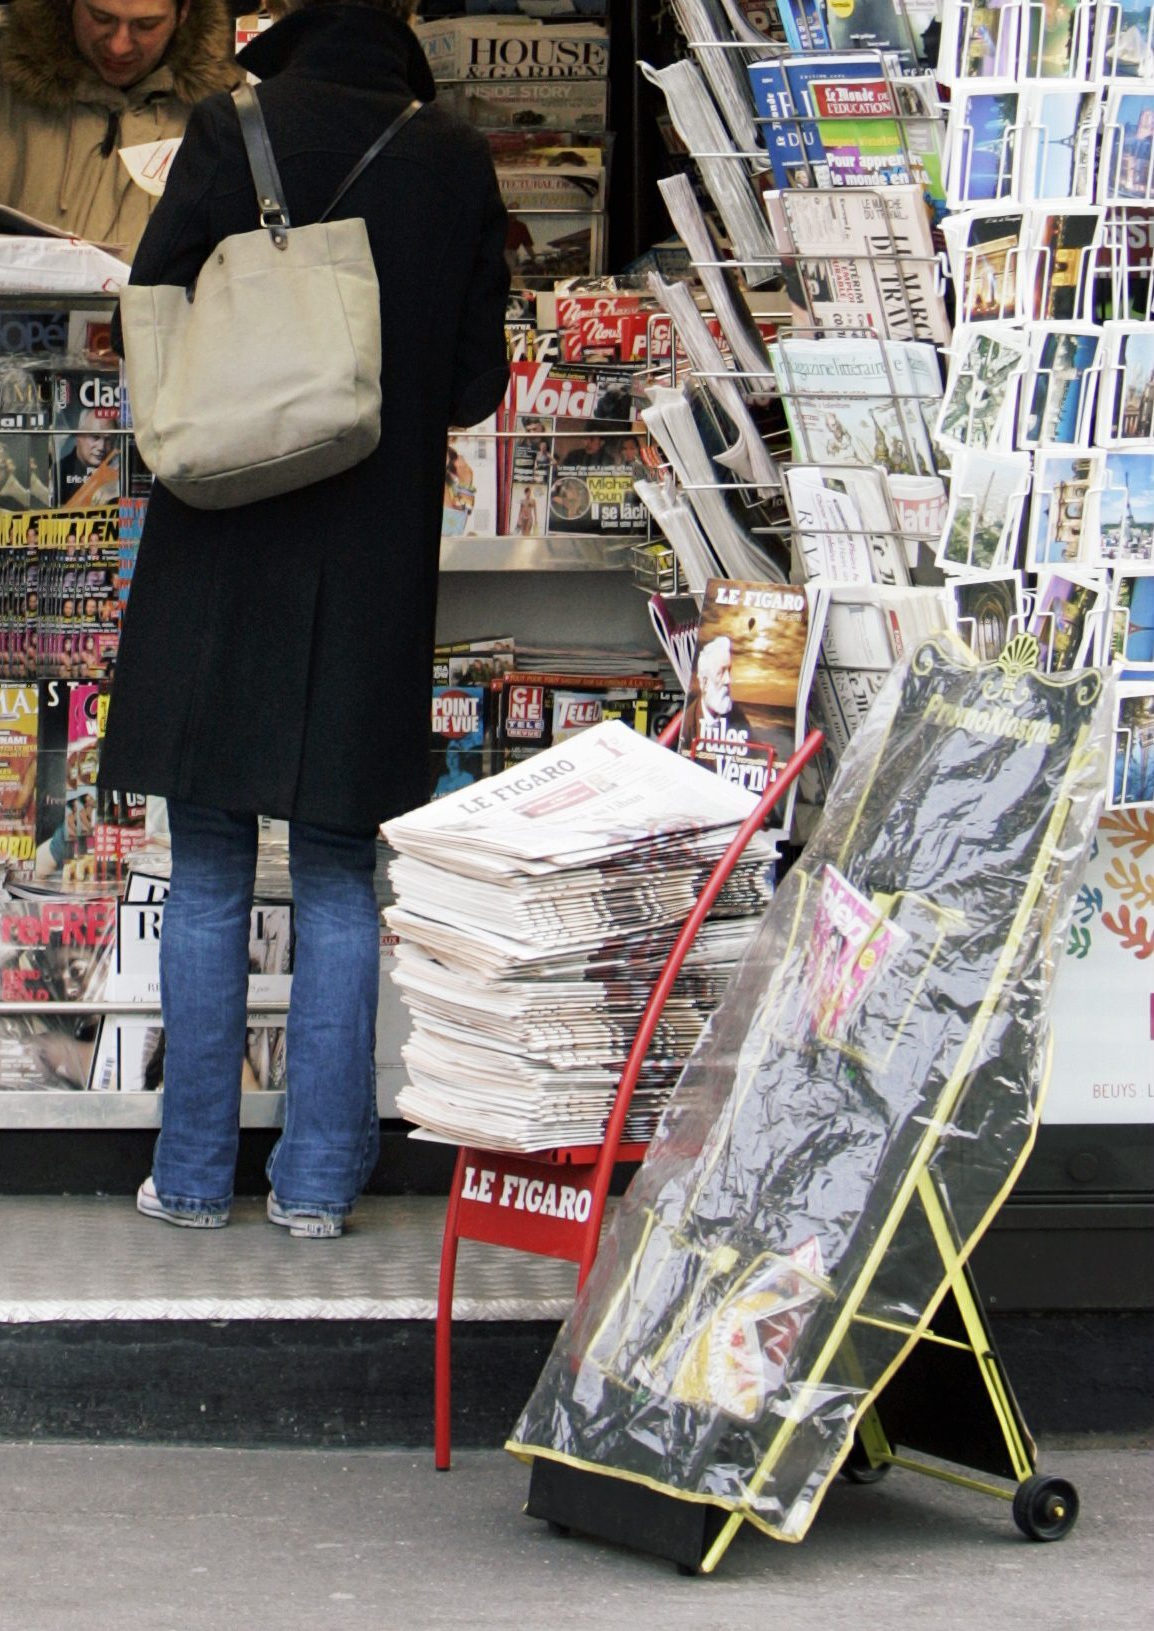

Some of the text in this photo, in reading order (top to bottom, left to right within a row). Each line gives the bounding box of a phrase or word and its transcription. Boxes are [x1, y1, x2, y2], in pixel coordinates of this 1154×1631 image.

[470, 37, 606, 66] HOUSE
[464, 85, 572, 99] INSIDE STORY
[838, 85, 875, 102] Monde
[827, 152, 857, 169] Pour
[832, 170, 909, 186] le monde en
[517, 361, 595, 418] Voici
[601, 505, 618, 521] se
[715, 586, 806, 613] LE FIGARO
[432, 697, 479, 716] POINT
[432, 716, 479, 733] DE VUE
[696, 718, 749, 755] Jules
[715, 756, 778, 794] Verne
[457, 758, 577, 815] LE FIGARO
[1092, 1083, 1136, 1099] BEUYS
[461, 1166, 593, 1223] LE FIGARO
